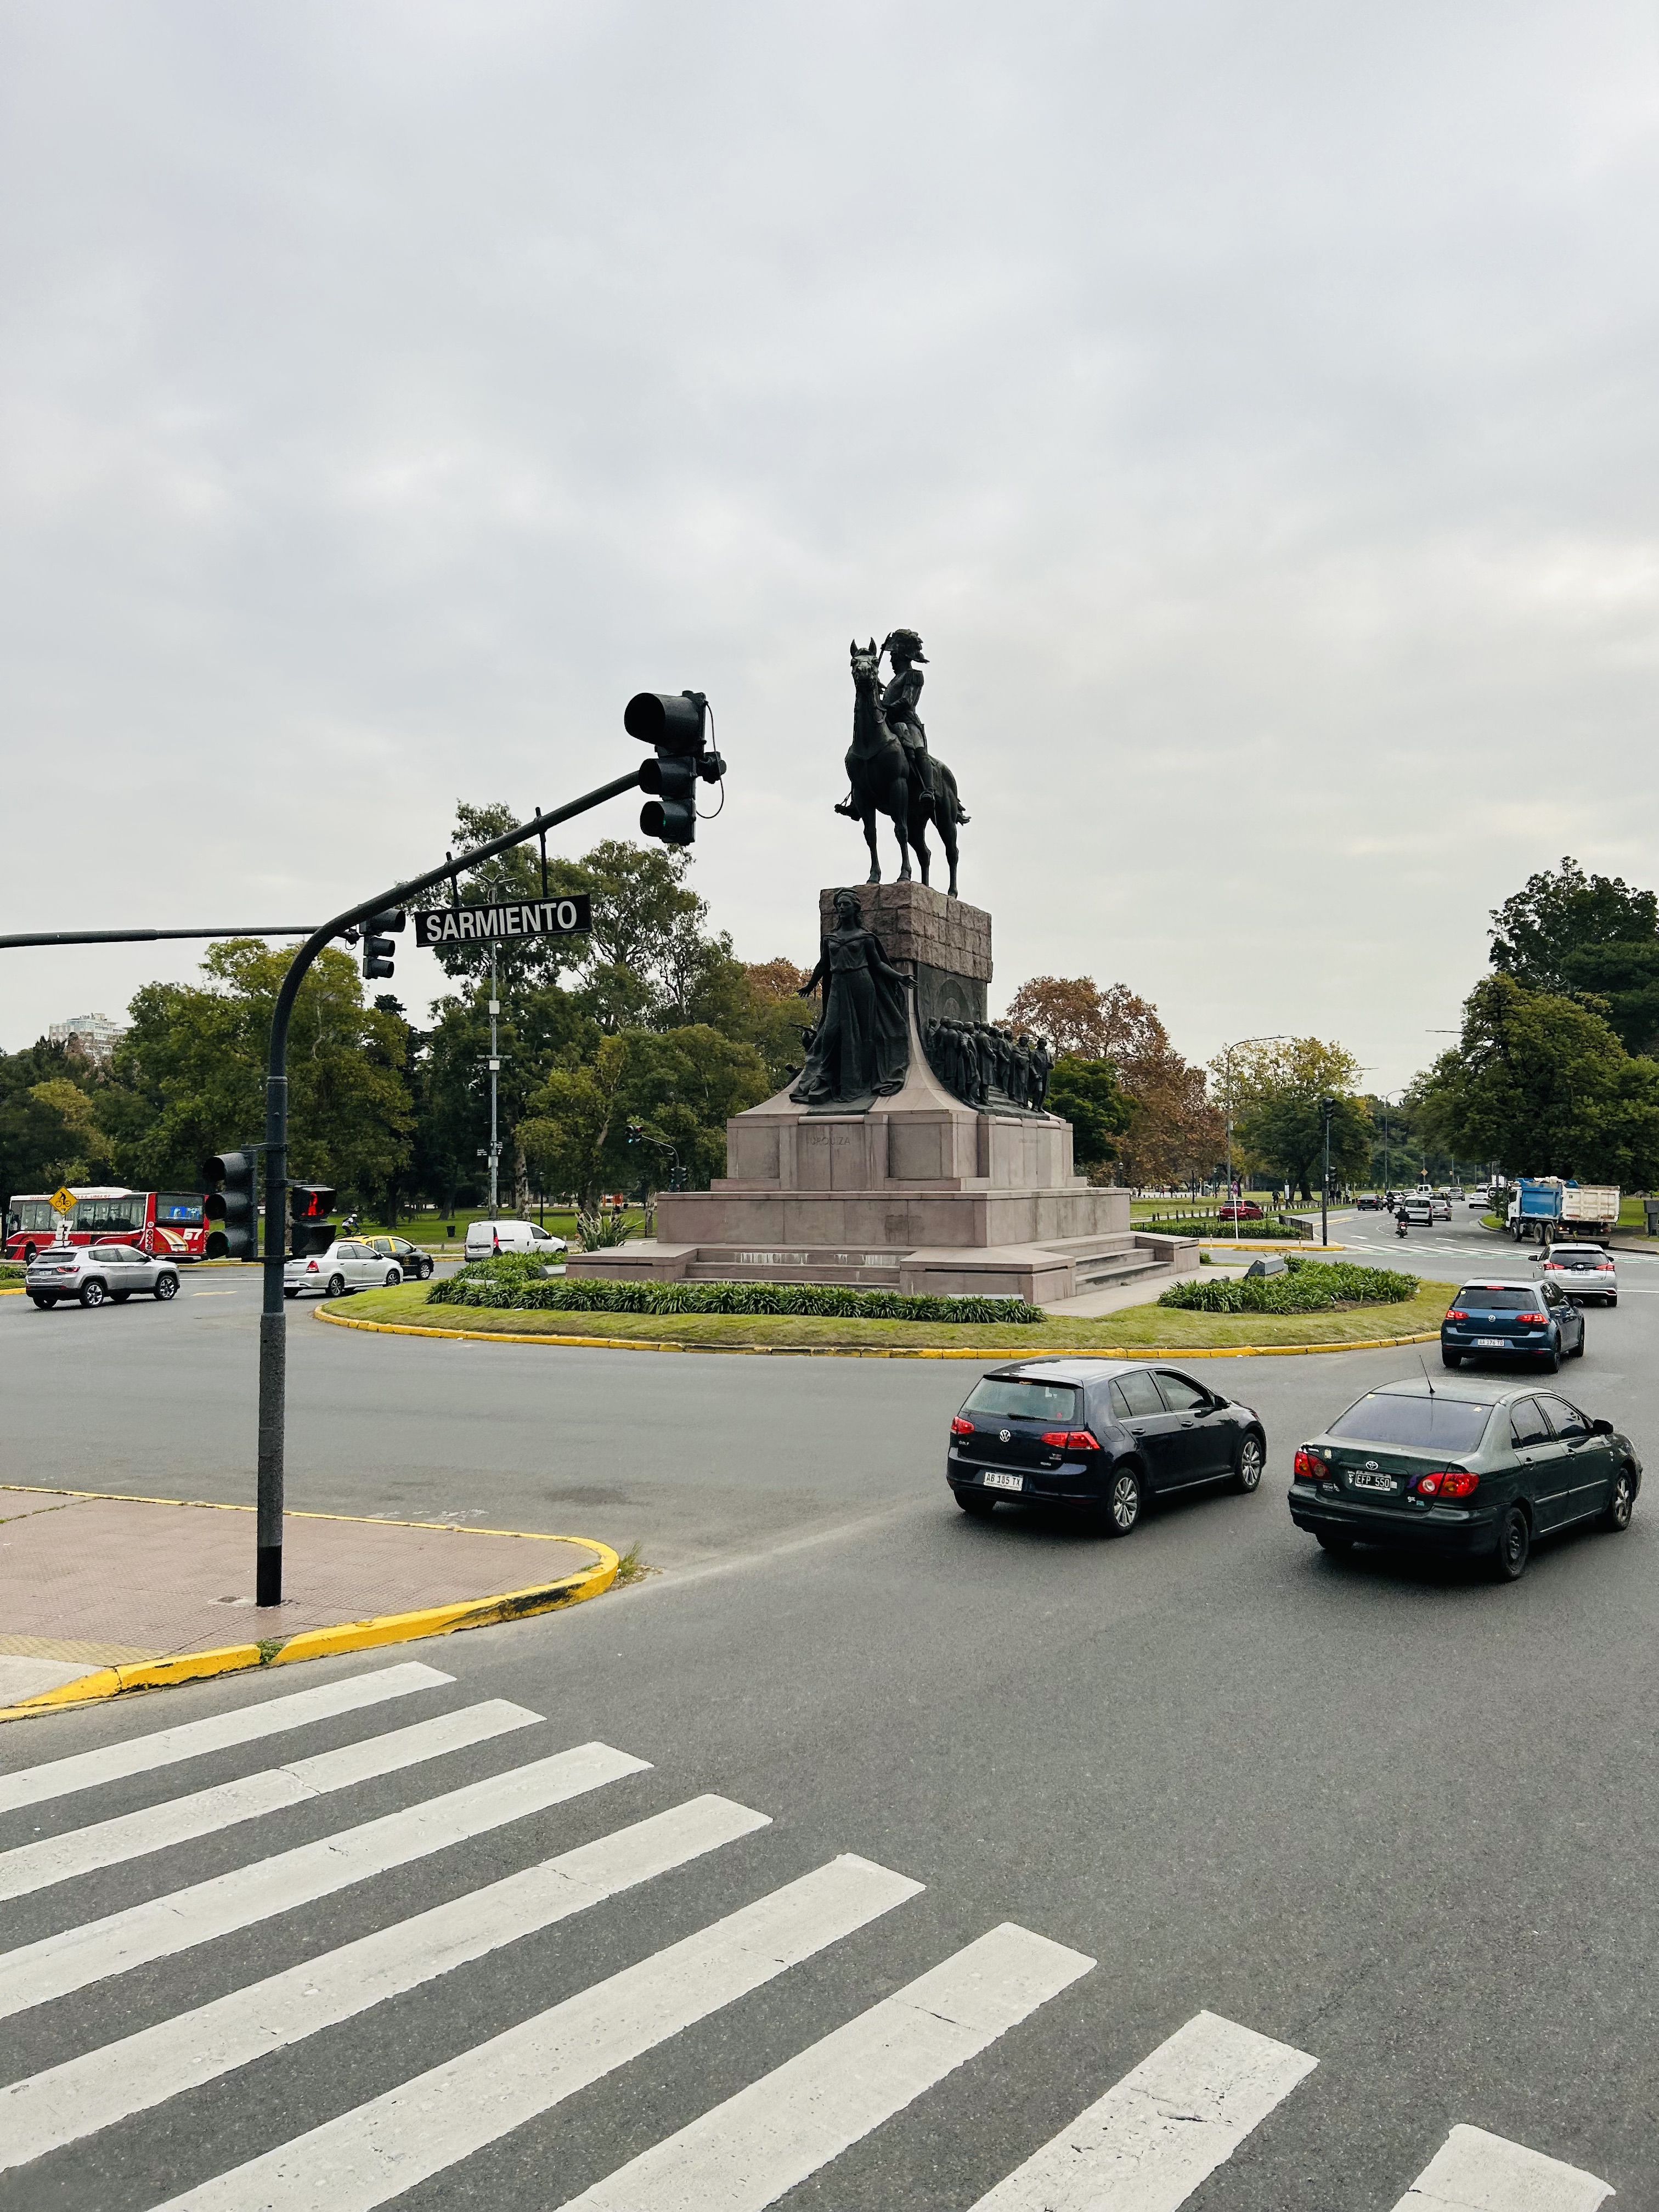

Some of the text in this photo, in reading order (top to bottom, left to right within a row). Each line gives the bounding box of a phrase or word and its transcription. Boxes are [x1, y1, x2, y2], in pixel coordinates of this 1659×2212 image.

[426, 901, 577, 941] SARMIENTO
[810, 1136, 851, 1146] URQUZA
[183, 1228, 203, 1240] 67
[986, 1474, 1020, 1486] AB 185 TX
[1357, 1474, 1390, 1487] EFP 550
